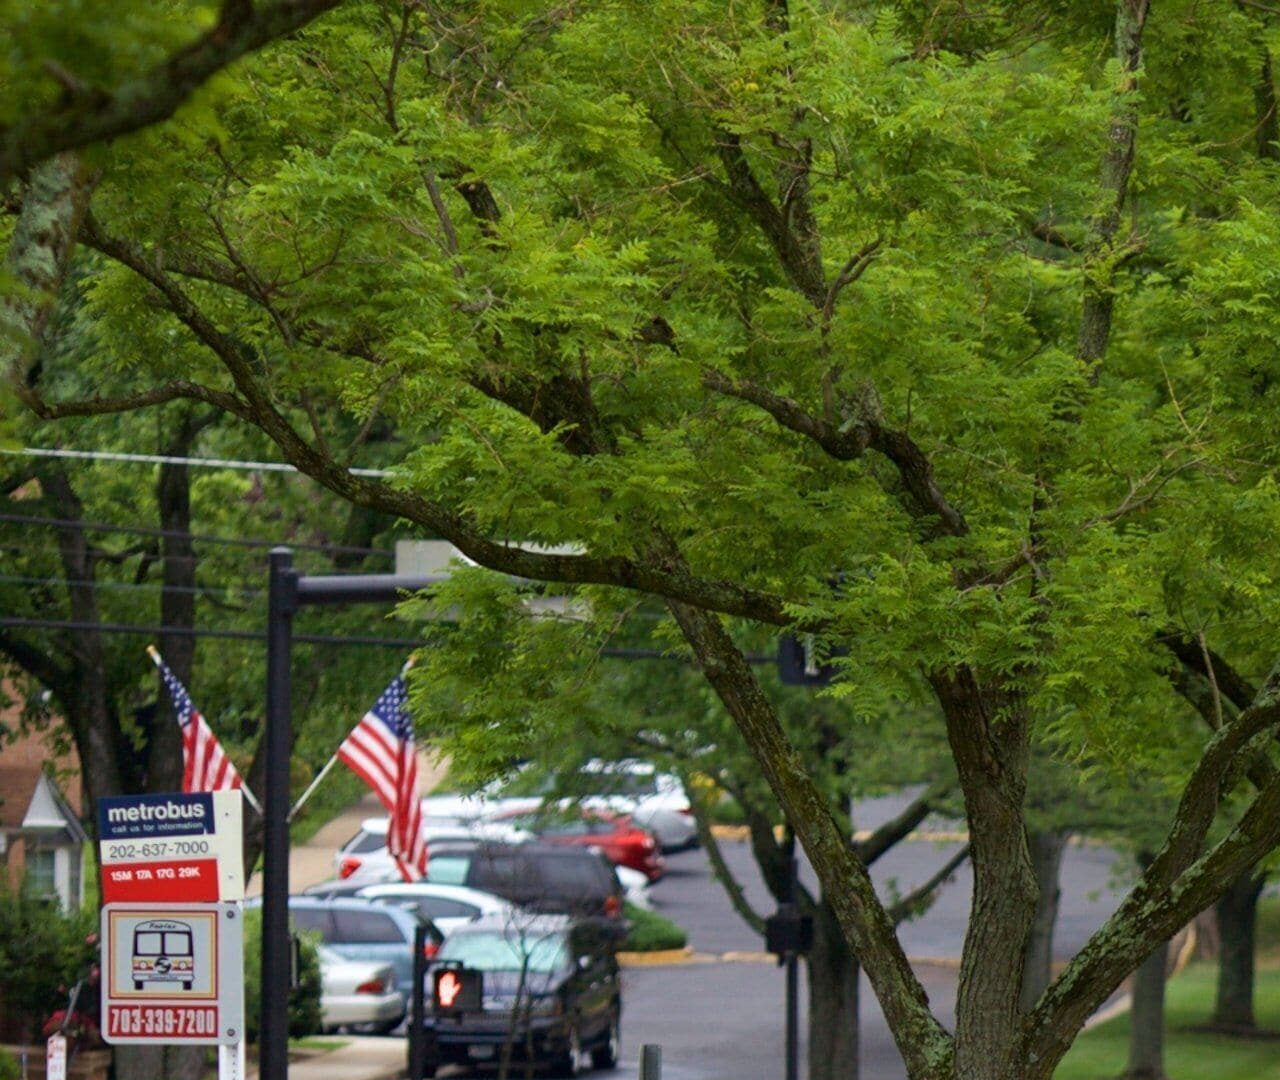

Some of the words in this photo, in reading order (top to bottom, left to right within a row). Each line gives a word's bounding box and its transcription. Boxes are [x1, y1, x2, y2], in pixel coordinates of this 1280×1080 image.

[108, 801, 205, 822] metrobus
[112, 825, 127, 833] call
[158, 822, 203, 830] information
[109, 841, 209, 858] 202-637-7000
[111, 871, 133, 881] 15M
[136, 870, 153, 880] 17A
[156, 868, 176, 878] 17G
[178, 867, 200, 878] 29K
[112, 1009, 215, 1034] 703-339-7200
